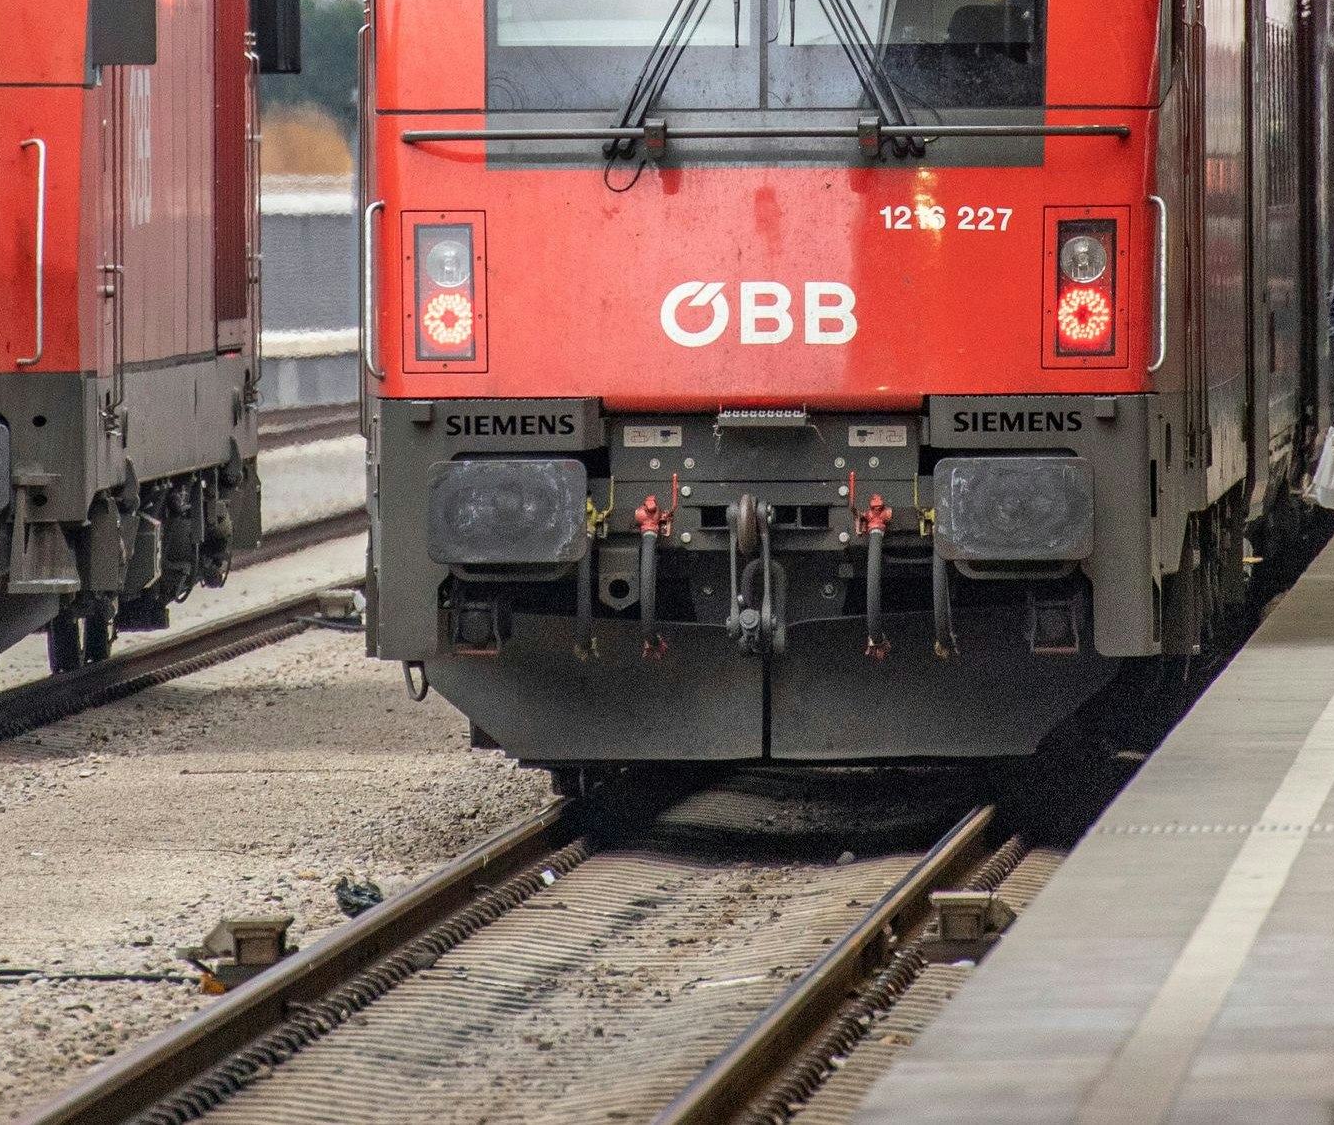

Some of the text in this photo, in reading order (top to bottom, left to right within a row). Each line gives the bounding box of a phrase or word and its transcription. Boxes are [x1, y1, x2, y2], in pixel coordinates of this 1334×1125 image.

[879, 205, 1013, 231] 1216 227
[660, 280, 858, 347] ÖBB
[446, 414, 575, 436] SIEMENS
[953, 410, 1083, 433] SIEMENS
